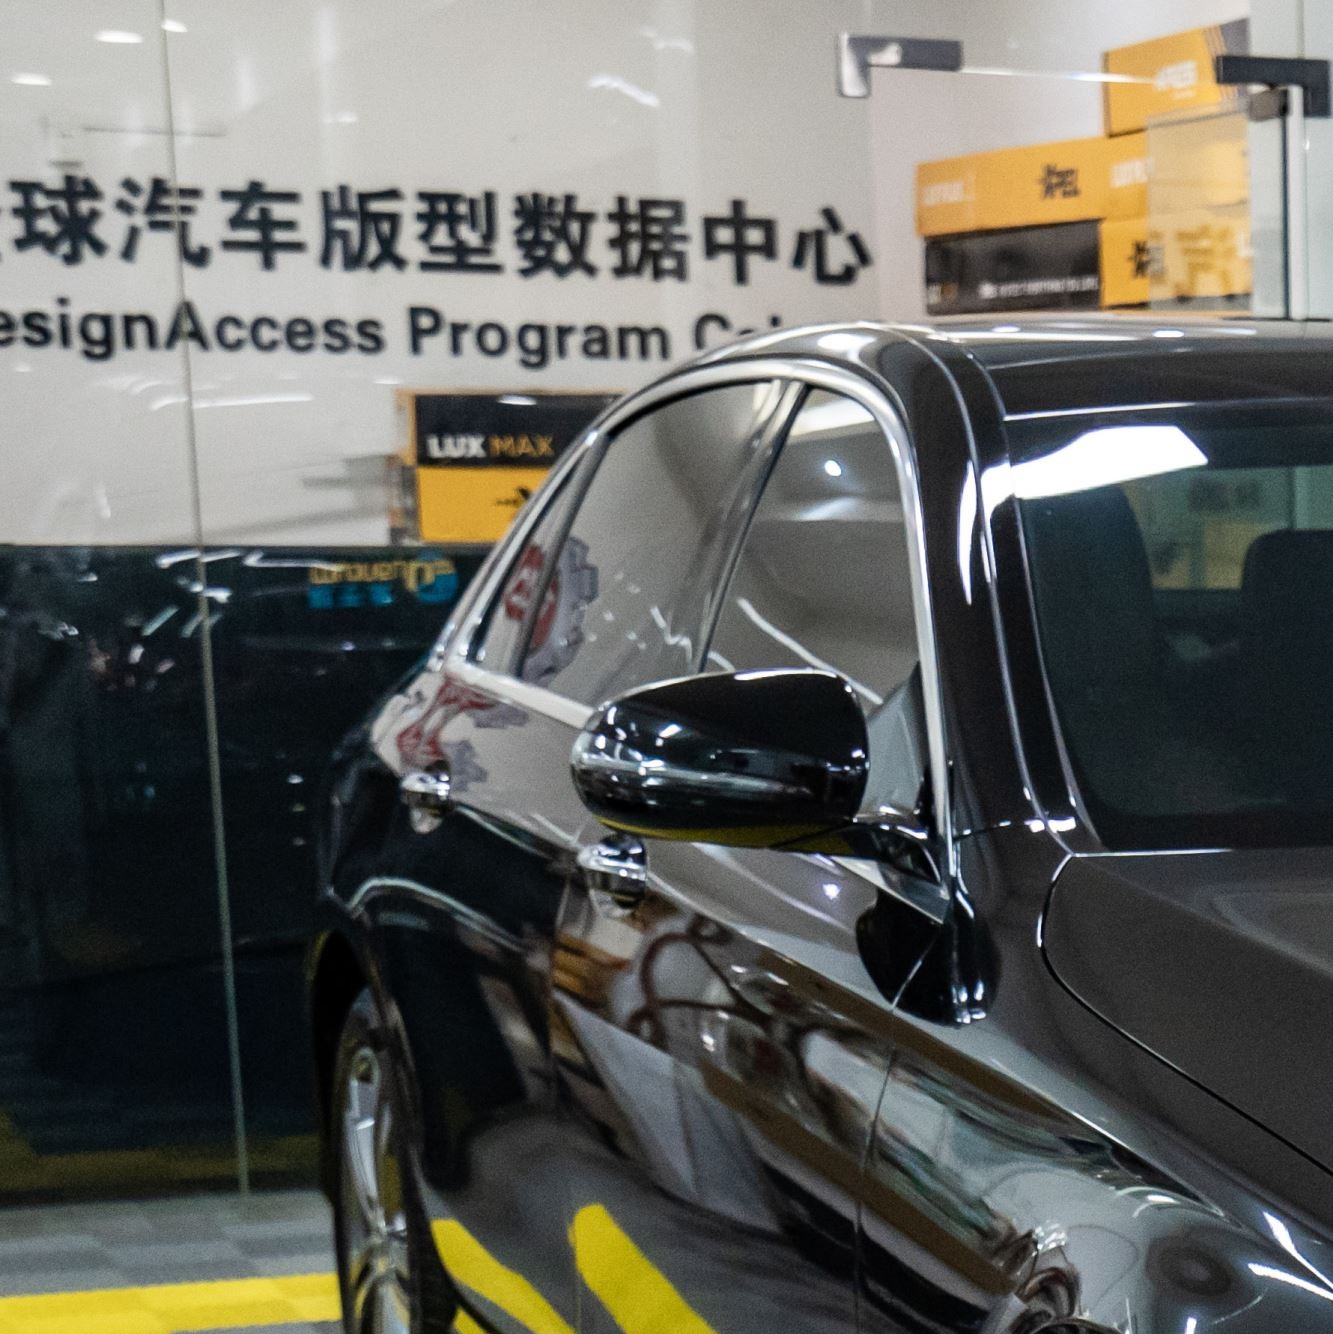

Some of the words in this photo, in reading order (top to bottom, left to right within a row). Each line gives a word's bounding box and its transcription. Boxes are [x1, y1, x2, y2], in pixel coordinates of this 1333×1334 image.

[0, 174, 871, 287] 球汽车版型数据中心
[408, 306, 671, 370] Program
[427, 433, 487, 459] LUX
[489, 433, 555, 458] MAX
